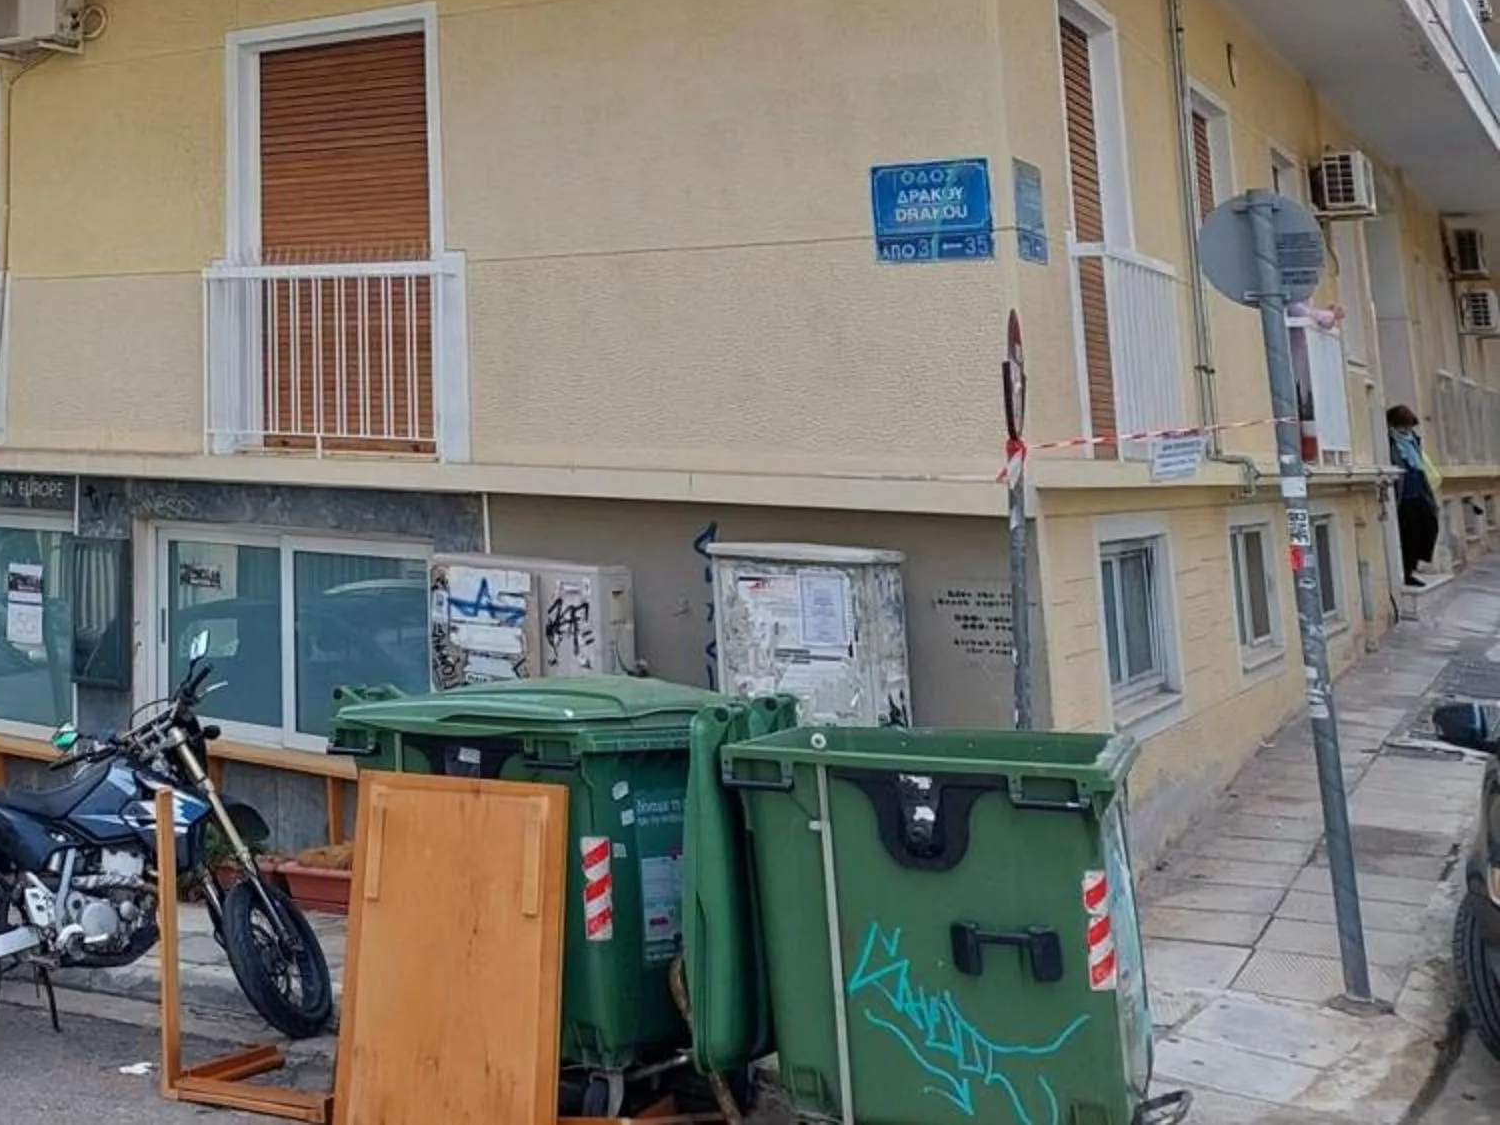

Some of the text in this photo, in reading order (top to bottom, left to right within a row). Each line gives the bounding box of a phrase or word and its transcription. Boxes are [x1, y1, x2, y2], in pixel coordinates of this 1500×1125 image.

[901, 169, 958, 185] ΟΔΟΣ
[897, 187, 964, 204] ΔΡΑΚΟΥ
[2, 480, 13, 495] IN
[19, 480, 64, 497] EUROPE
